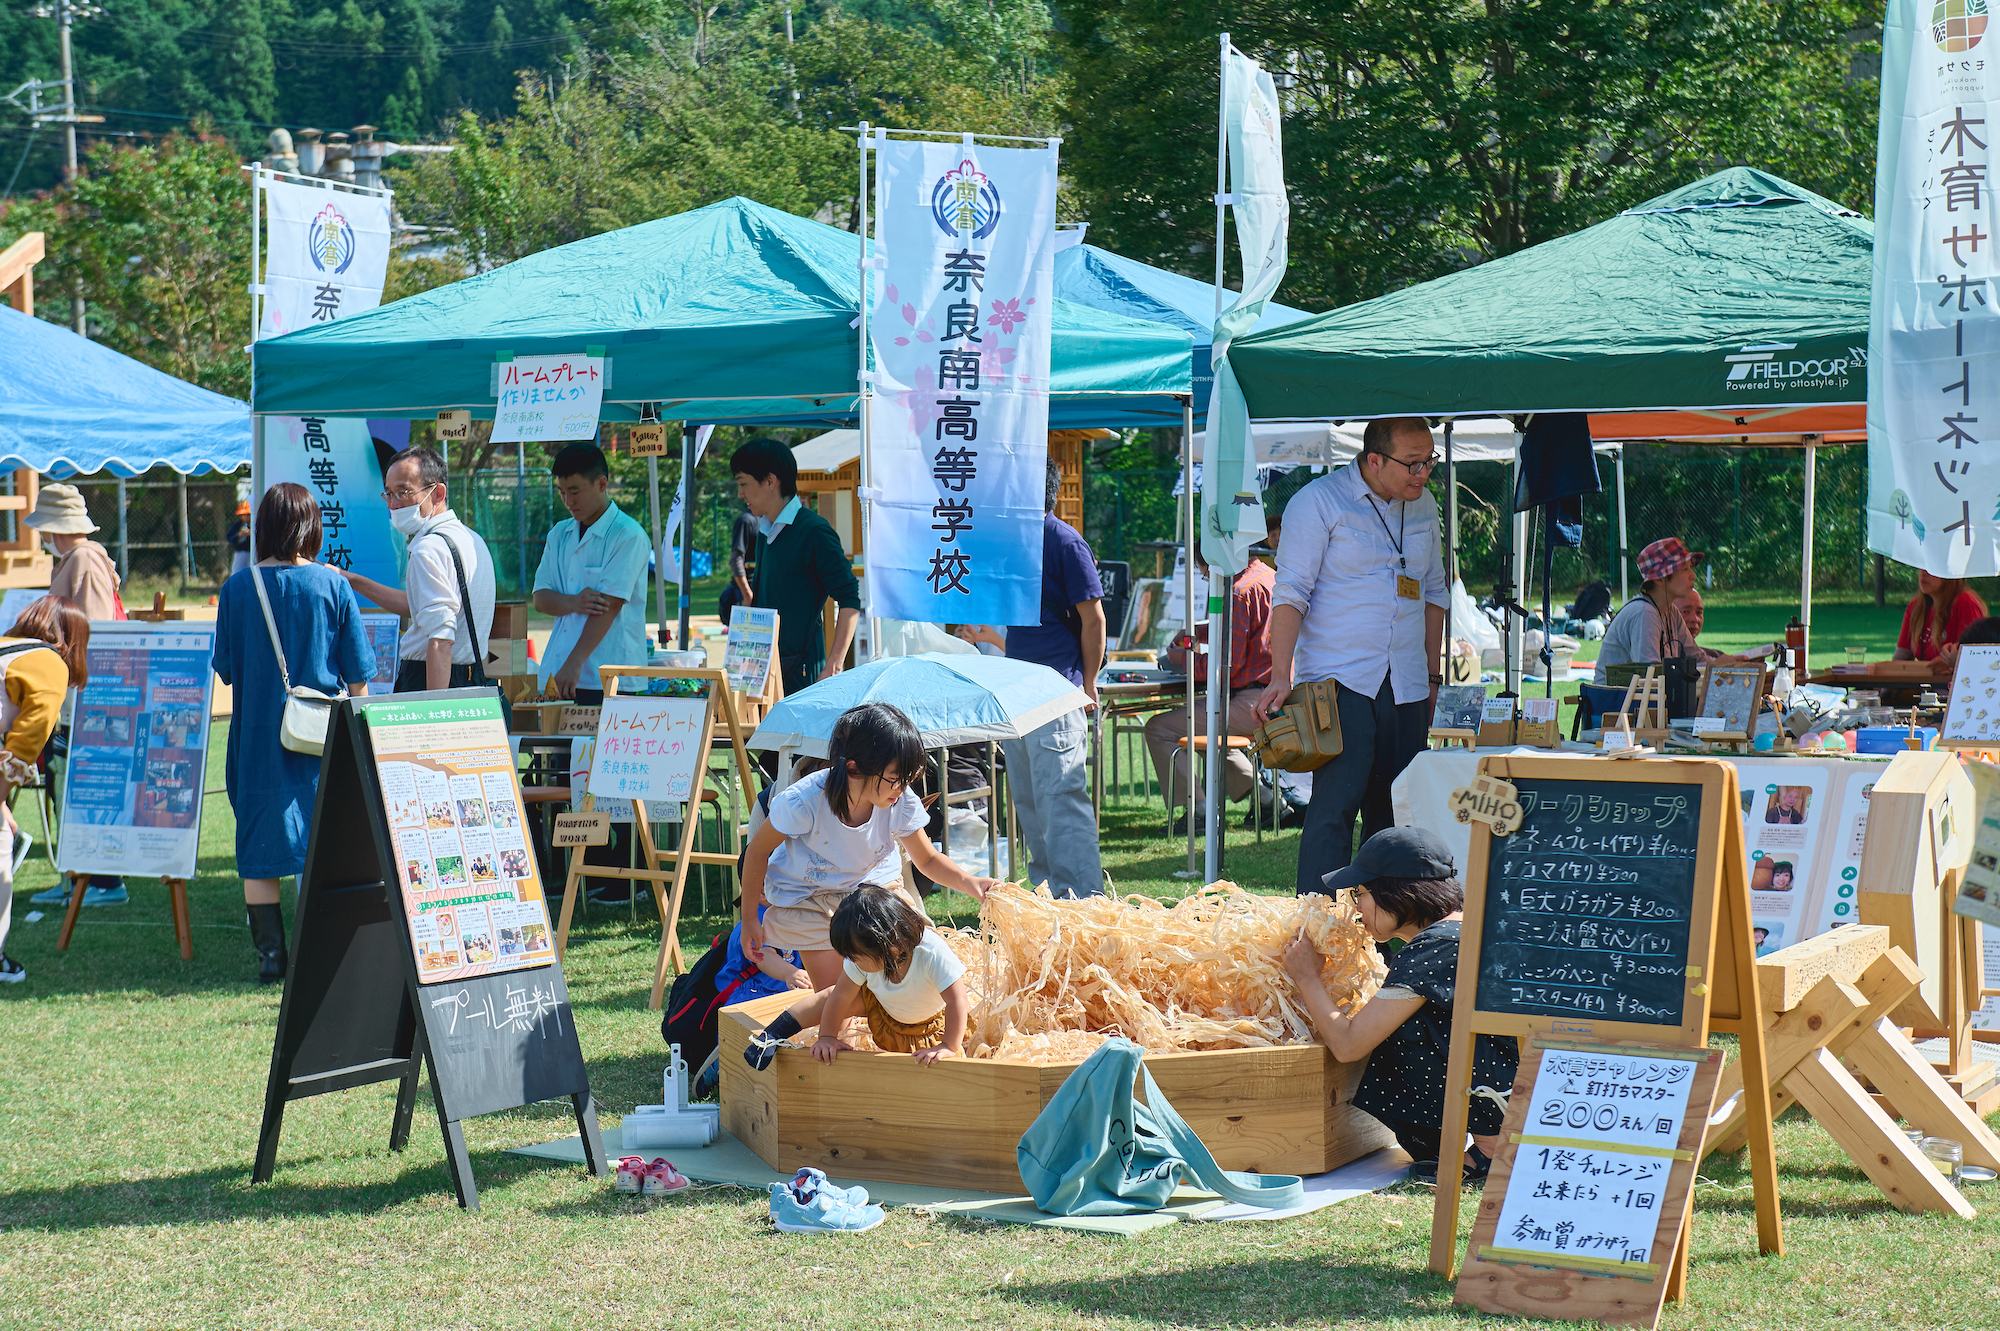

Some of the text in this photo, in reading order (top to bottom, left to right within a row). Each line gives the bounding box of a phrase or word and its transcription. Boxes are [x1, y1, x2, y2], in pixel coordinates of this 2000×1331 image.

[504, 363, 599, 385] ルームプレート
[1753, 358, 1848, 379] FIELDOOR
[1726, 376, 1849, 391] Powered by ottostyle.jp
[501, 386, 585, 407] 作りませんか
[501, 410, 545, 423] 奈良南高校
[564, 421, 590, 433] 500円
[926, 248, 986, 594] 奈良南高等学校
[516, 425, 544, 437] 専攻科
[604, 710, 697, 733] ルームプレート
[603, 737, 685, 755] 作りませんか
[601, 760, 650, 775] 奈良南高校
[617, 778, 650, 793] 専攻科
[671, 781, 688, 793] 500円
[655, 808, 675, 817] 500円
[557, 819, 598, 828] DRAFTING
[560, 834, 587, 842] WORK
[1511, 987, 1605, 1011] コースター作り
[431, 981, 563, 1039] プール無料
[1546, 1055, 1690, 1084] 木育チャレンジ
[1586, 1080, 1675, 1101] 釘打ちマスター
[1538, 1148, 1662, 1181] 1発チャレンジ
[1532, 1180, 1600, 1201] 出来たら
[1512, 1214, 1575, 1250] 参加賞
